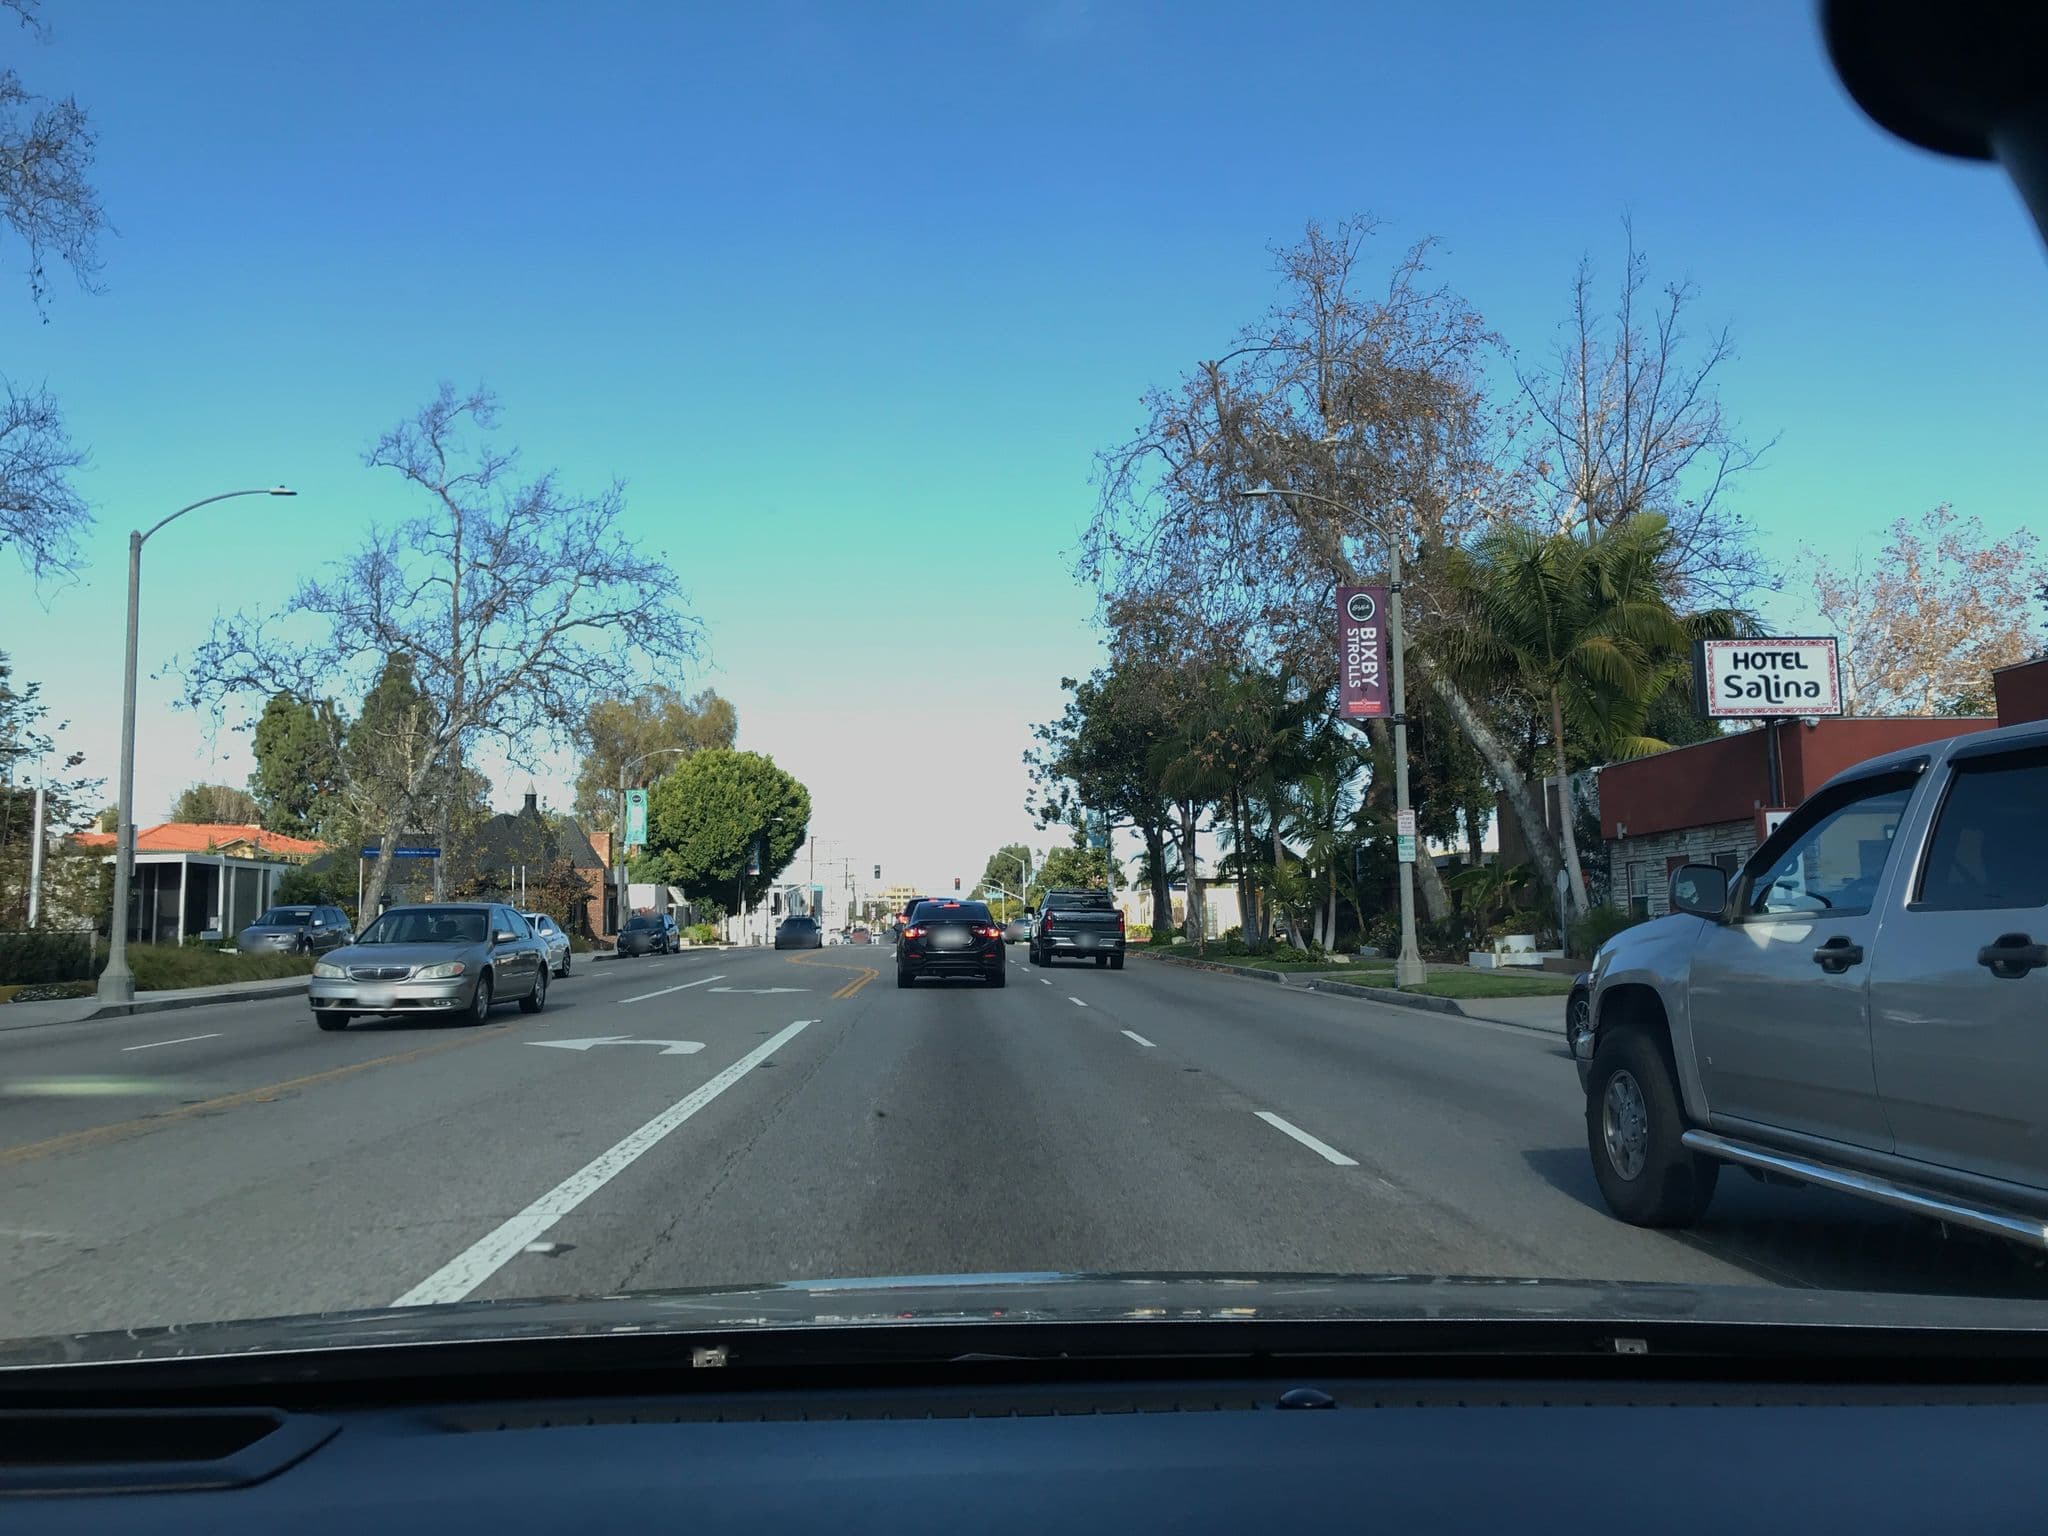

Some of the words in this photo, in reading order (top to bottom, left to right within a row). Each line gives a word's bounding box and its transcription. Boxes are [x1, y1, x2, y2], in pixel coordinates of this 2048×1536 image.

[1347, 628, 1361, 688] STROLLS
[1360, 627, 1379, 688] BIXBY
[1732, 651, 1809, 671] HOTEL
[1723, 674, 1821, 704] Salina
